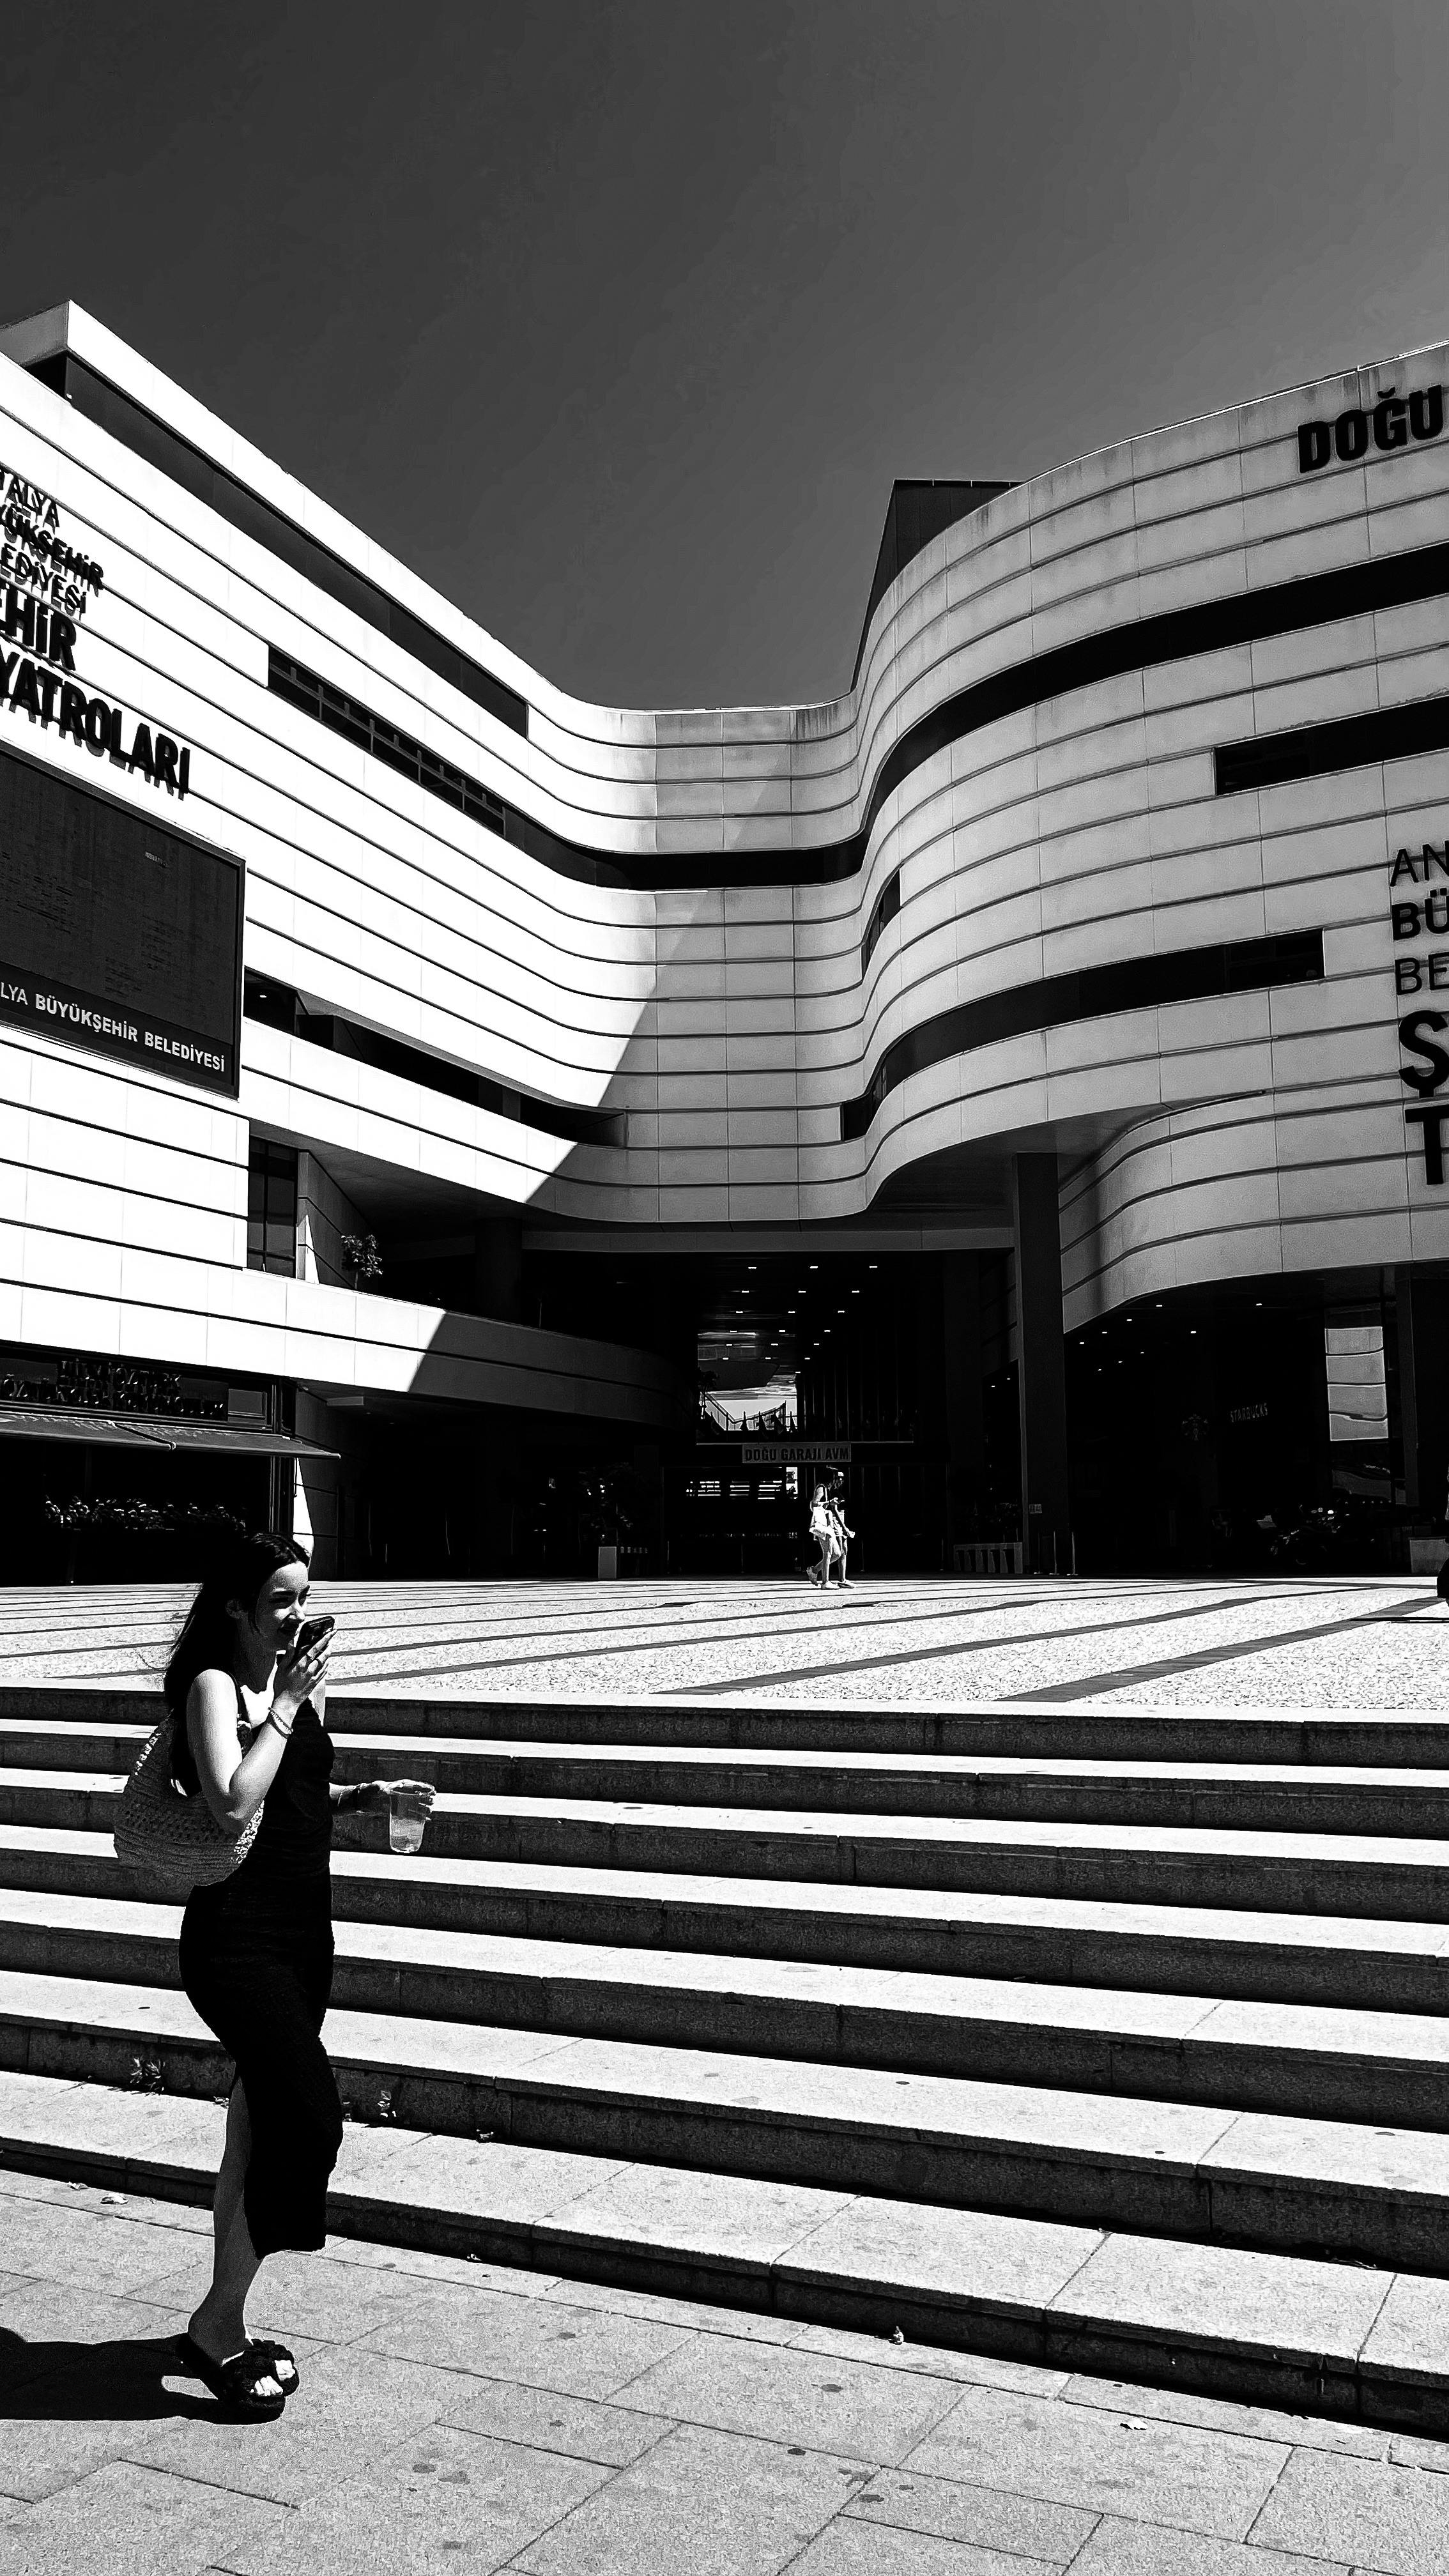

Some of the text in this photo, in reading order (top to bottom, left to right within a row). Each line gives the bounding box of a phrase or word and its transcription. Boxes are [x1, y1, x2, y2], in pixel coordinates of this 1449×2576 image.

[1298, 385, 1444, 473] DOĞU
[1392, 887, 1449, 941] BÜ
[1395, 952, 1449, 996] BE
[1, 982, 225, 1072] LYA BÜYÜKŞEHİR BELEDİYESİ
[1398, 1009, 1449, 1099] Ş
[1404, 1103, 1449, 1185] T
[1230, 1402, 1268, 1423] STARBUCKS
[745, 1446, 849, 1461] DOĞU GARAJI AVM
